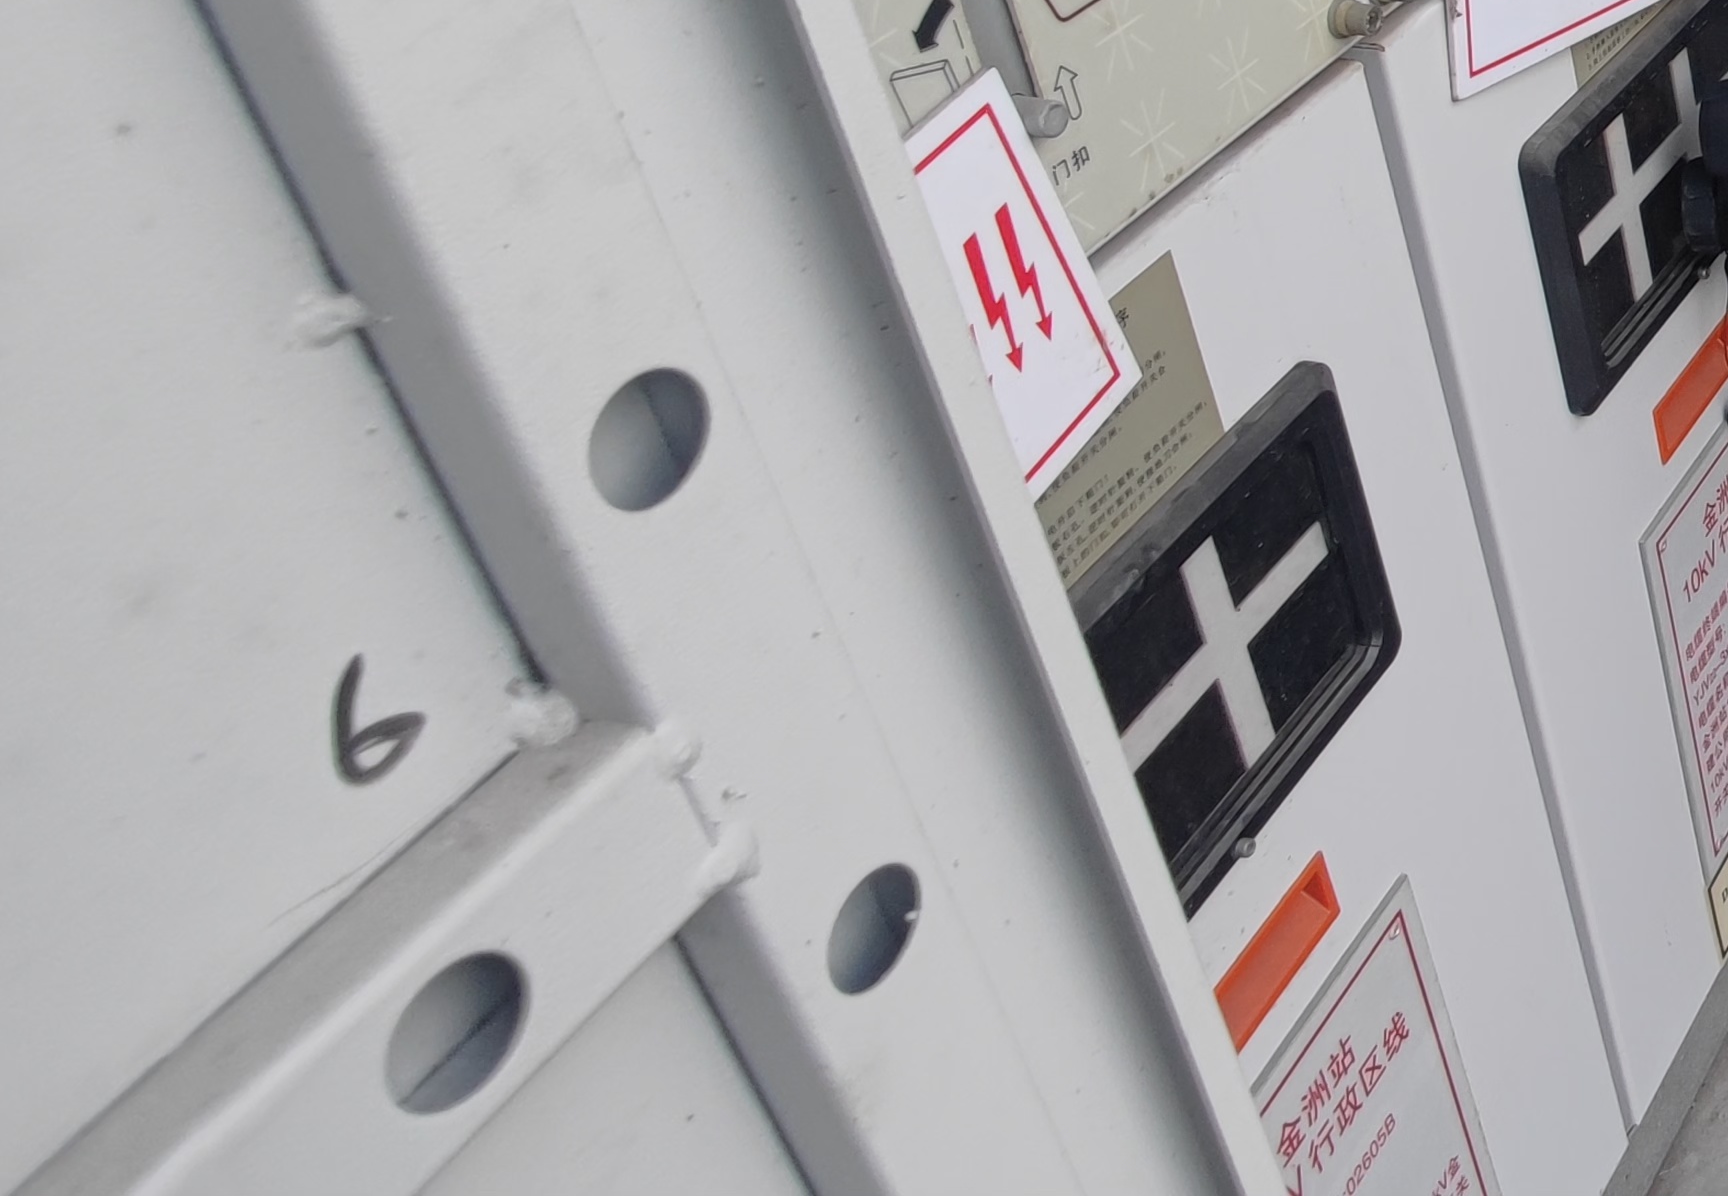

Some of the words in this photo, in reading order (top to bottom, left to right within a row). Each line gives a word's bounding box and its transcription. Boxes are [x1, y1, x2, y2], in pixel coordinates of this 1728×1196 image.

[1052, 145, 1091, 187] 门扣
[1682, 538, 1716, 603] 10kV
[332, 653, 426, 787] 6
[1277, 1034, 1355, 1168] 金洲站
[1308, 1011, 1410, 1174] 行政区线
